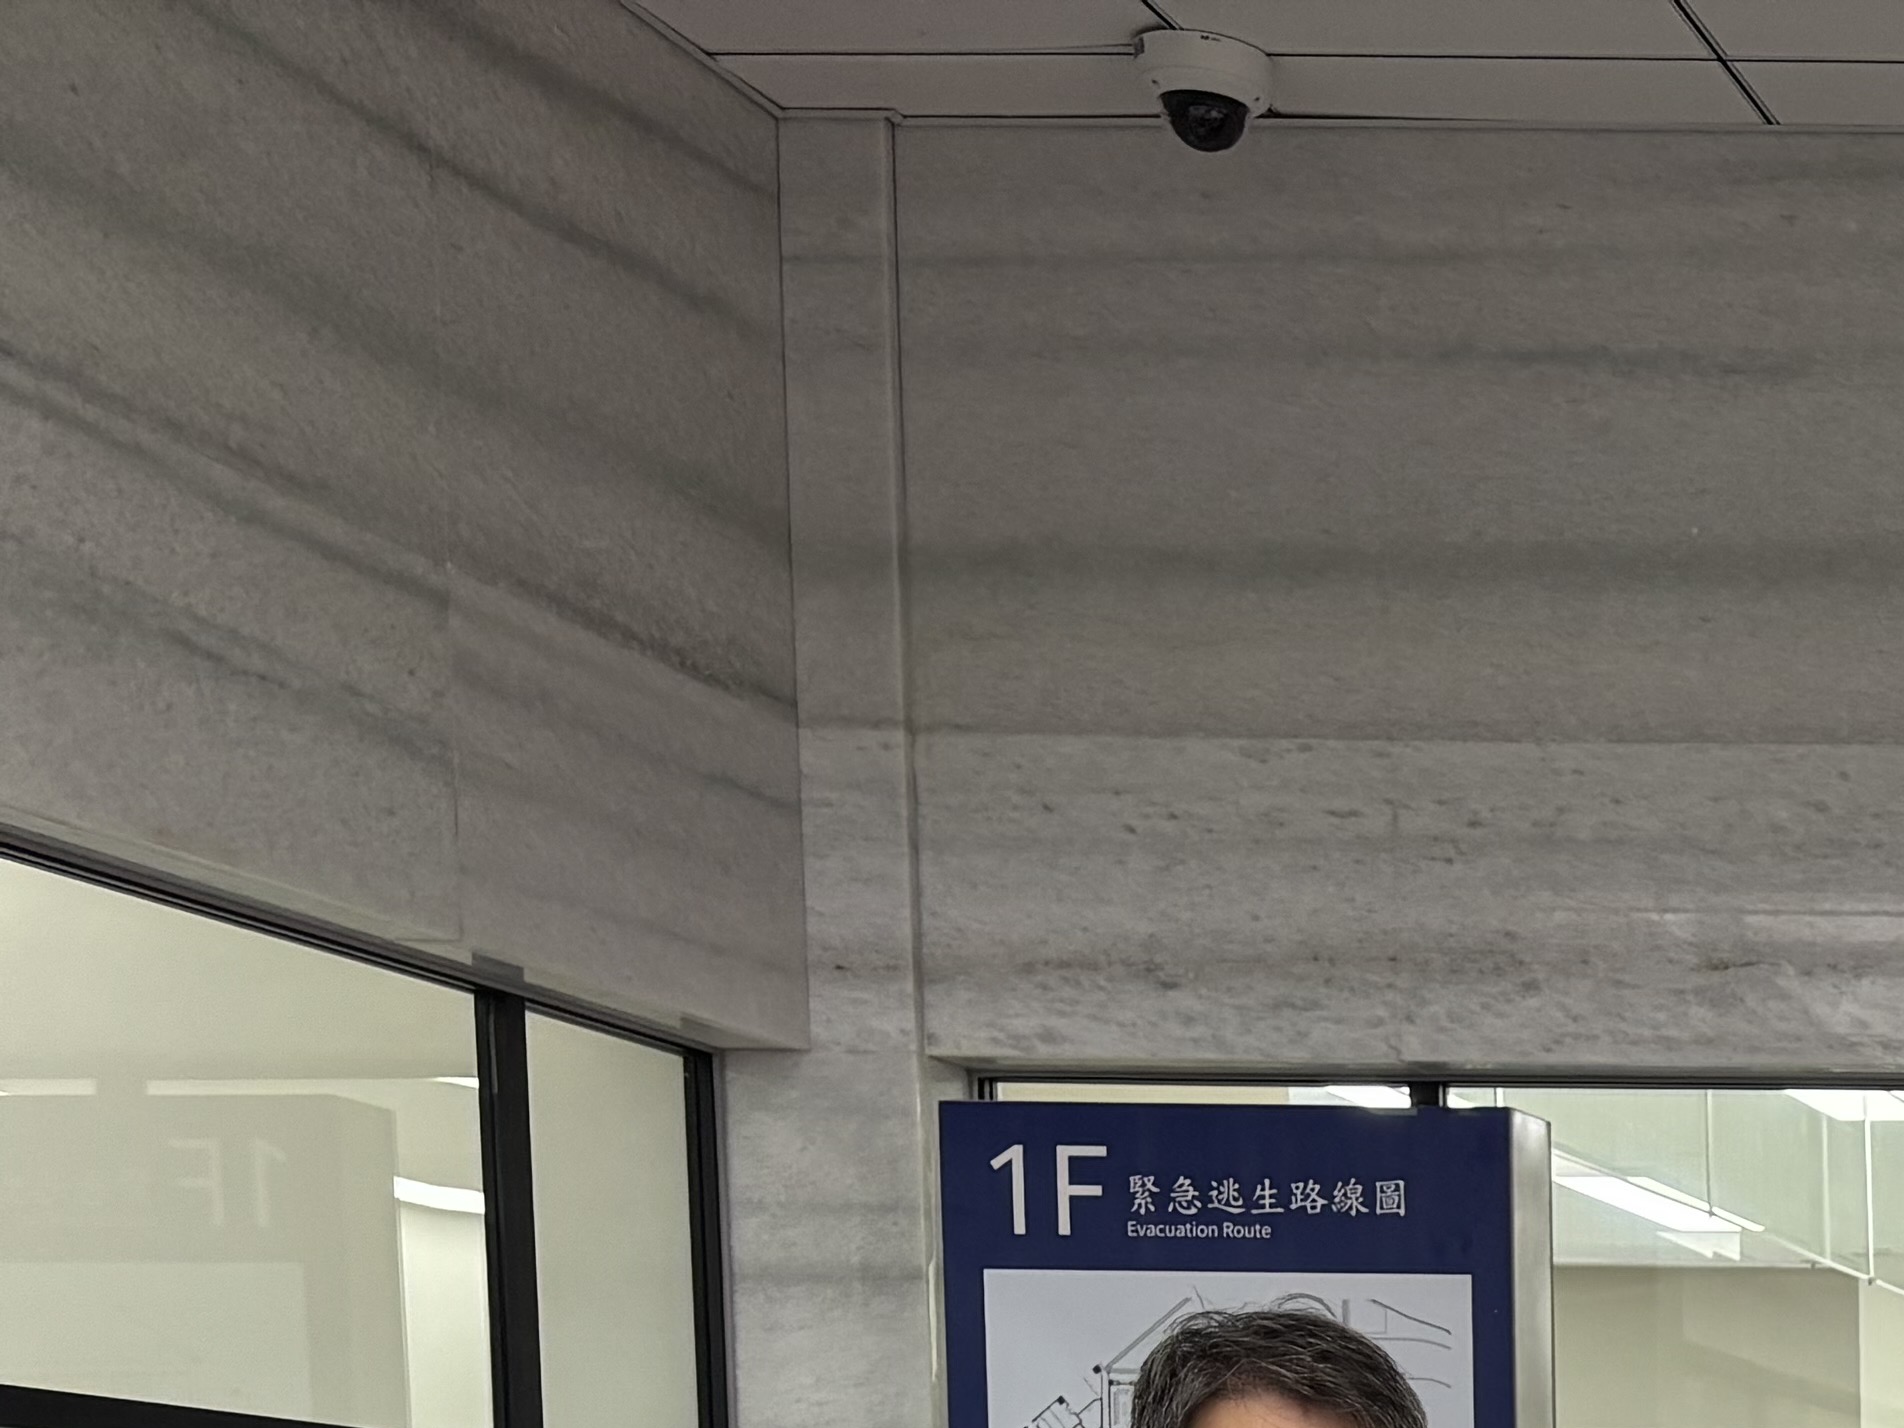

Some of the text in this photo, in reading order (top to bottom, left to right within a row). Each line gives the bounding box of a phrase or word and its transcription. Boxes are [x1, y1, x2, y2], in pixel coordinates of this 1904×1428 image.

[990, 1143, 1108, 1236] 1F
[1128, 1174, 1407, 1217] 緊急逃生路線圖
[1127, 1220, 1272, 1239] Evacuation Route
